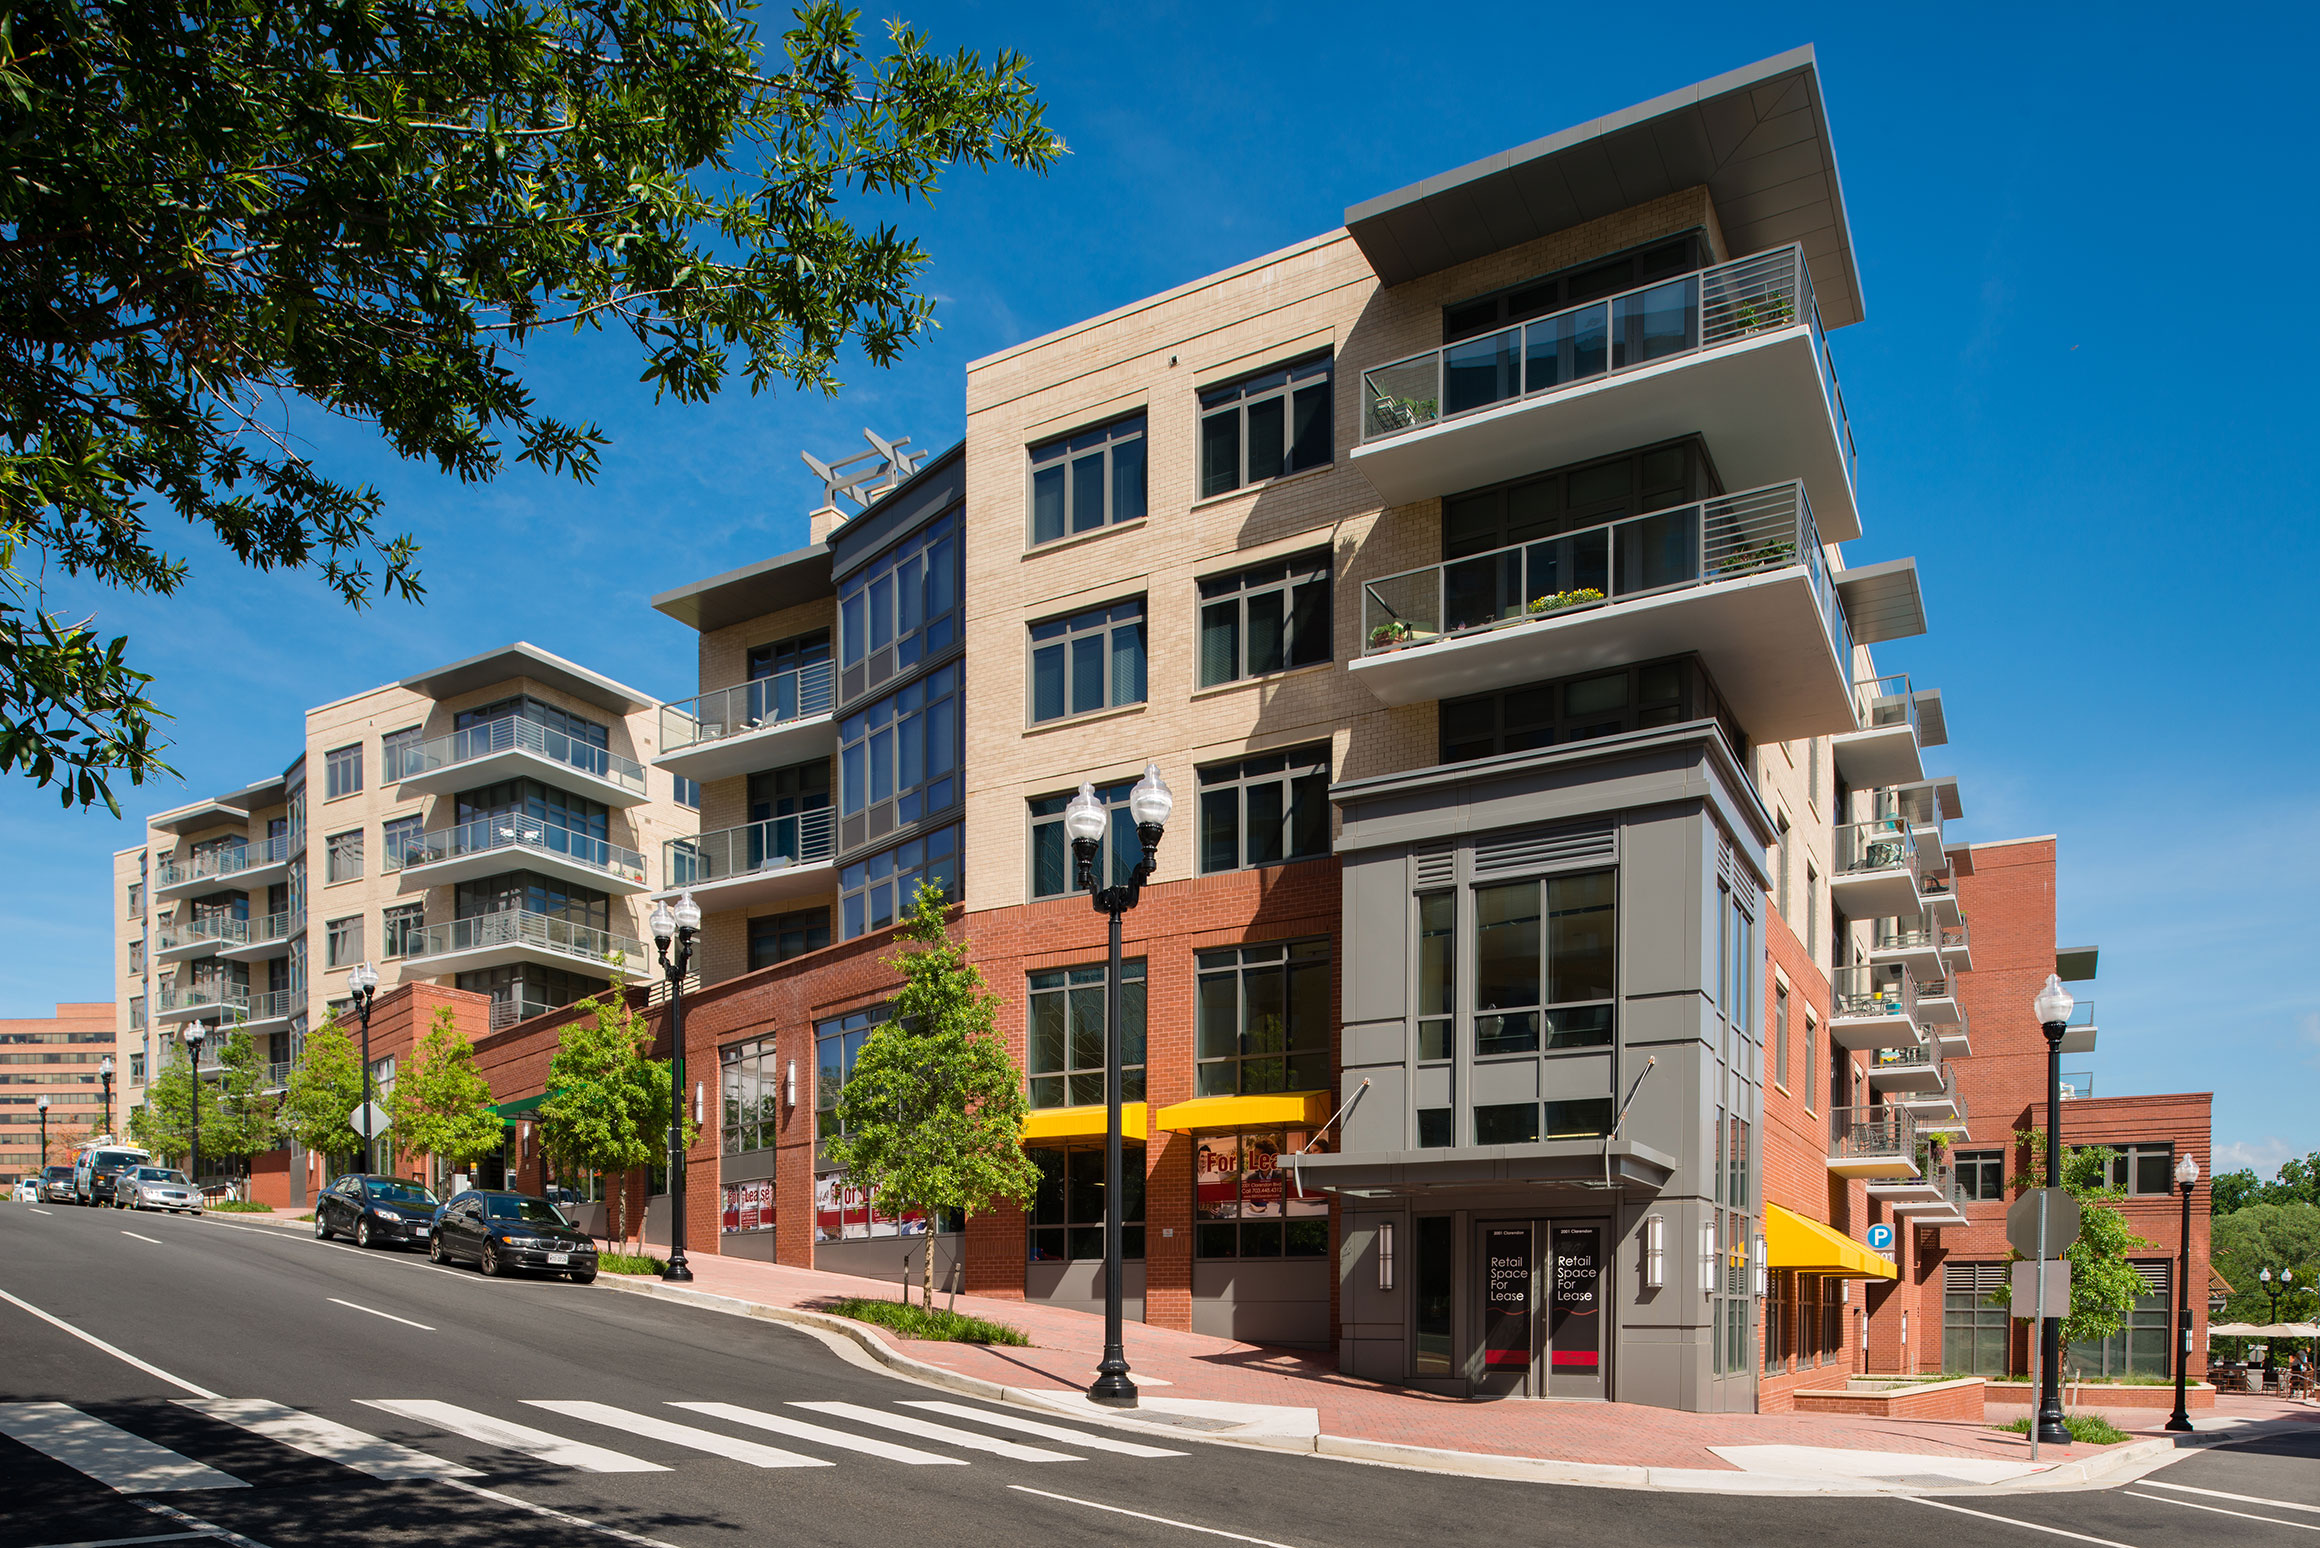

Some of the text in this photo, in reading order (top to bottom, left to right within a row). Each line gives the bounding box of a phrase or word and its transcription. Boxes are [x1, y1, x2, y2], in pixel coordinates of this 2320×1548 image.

[1207, 1152, 1236, 1172] For
[727, 1188, 769, 1205] For Lease
[834, 1184, 856, 1206] For
[1875, 1229, 1888, 1246] P
[1491, 1256, 1522, 1267] Retail
[1558, 1255, 1591, 1267] Retail
[1490, 1268, 1528, 1280] Space
[1557, 1267, 1597, 1280] Space
[1490, 1280, 1508, 1290] For
[1557, 1279, 1576, 1289] For
[1490, 1291, 1524, 1301] Lease
[1557, 1290, 1592, 1301] Lease
